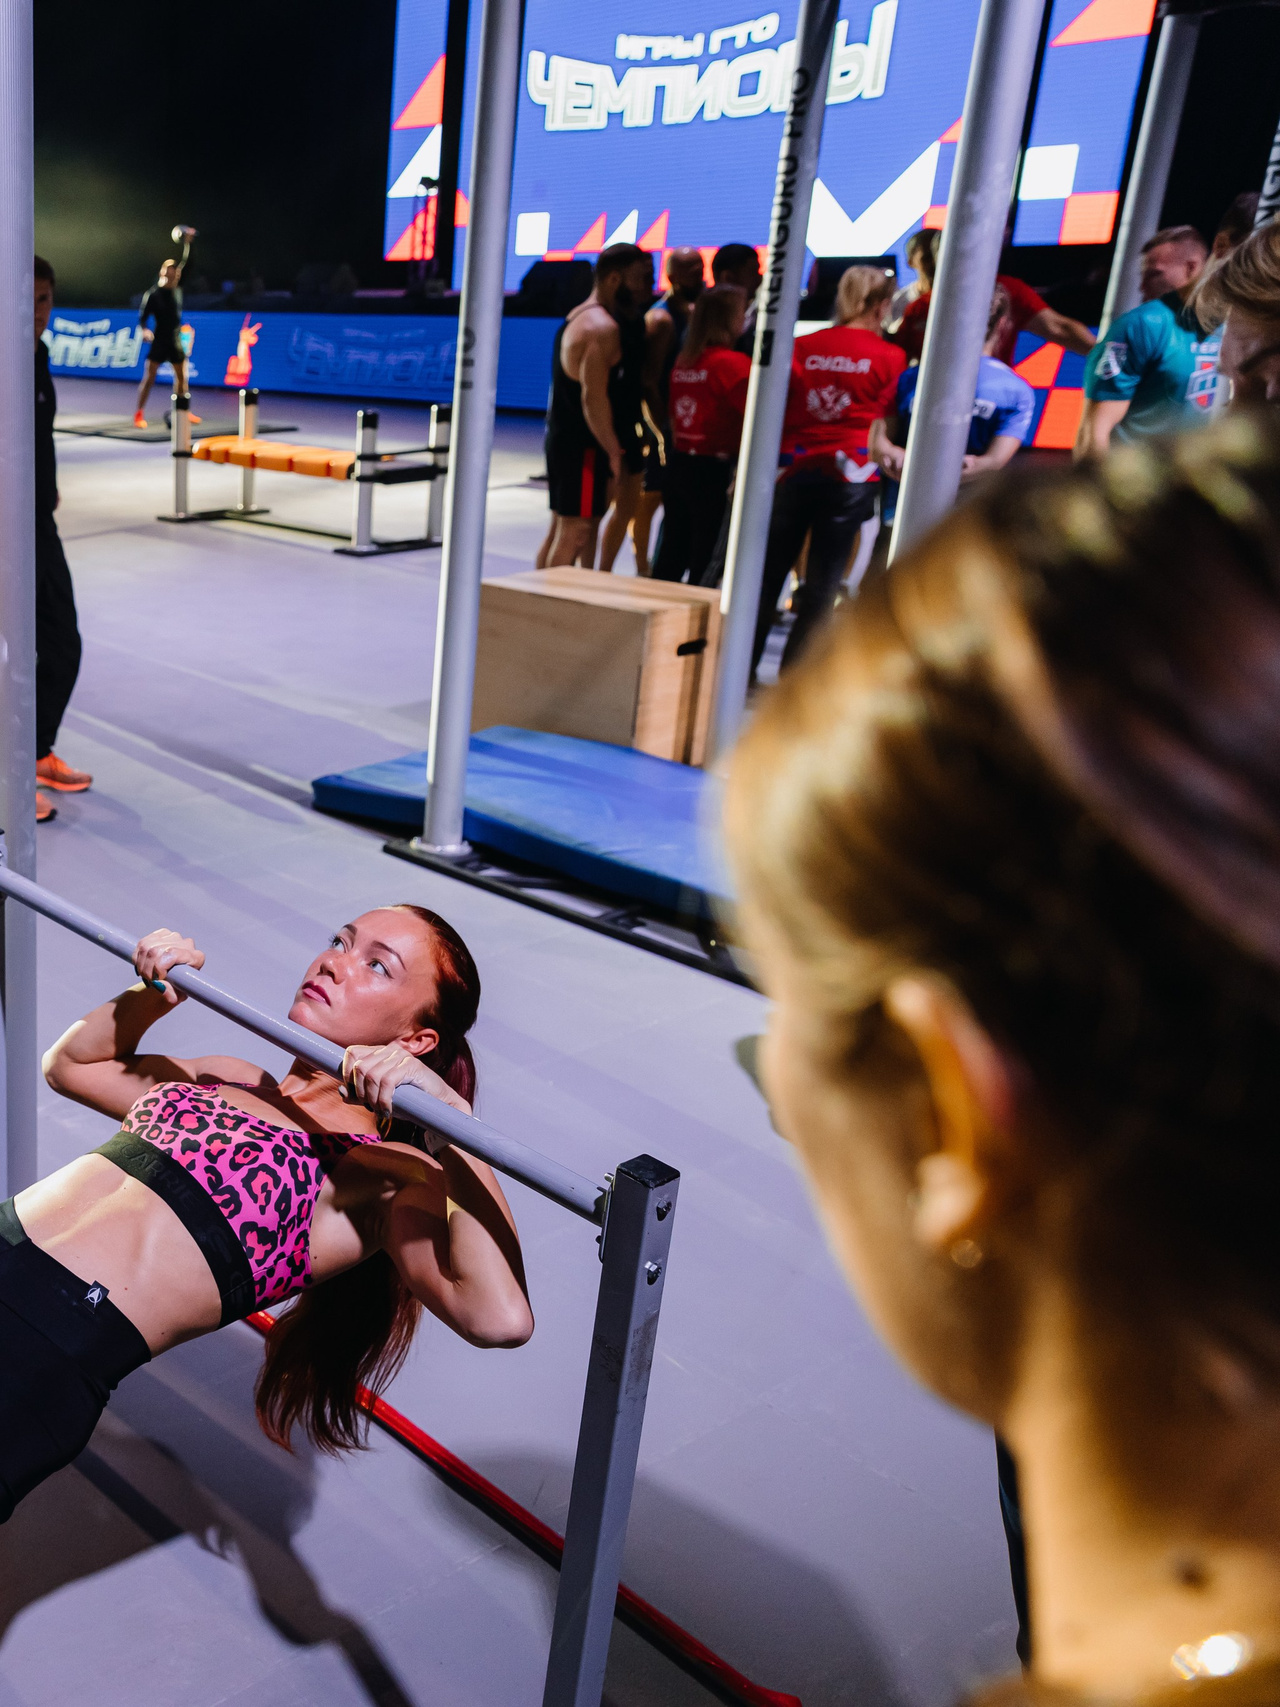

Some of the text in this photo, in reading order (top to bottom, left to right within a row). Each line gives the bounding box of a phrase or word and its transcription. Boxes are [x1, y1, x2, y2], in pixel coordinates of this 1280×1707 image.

[616, 13, 780, 60] ИГРЫ ГТО
[805, 354, 871, 374] СУДЬЯ
